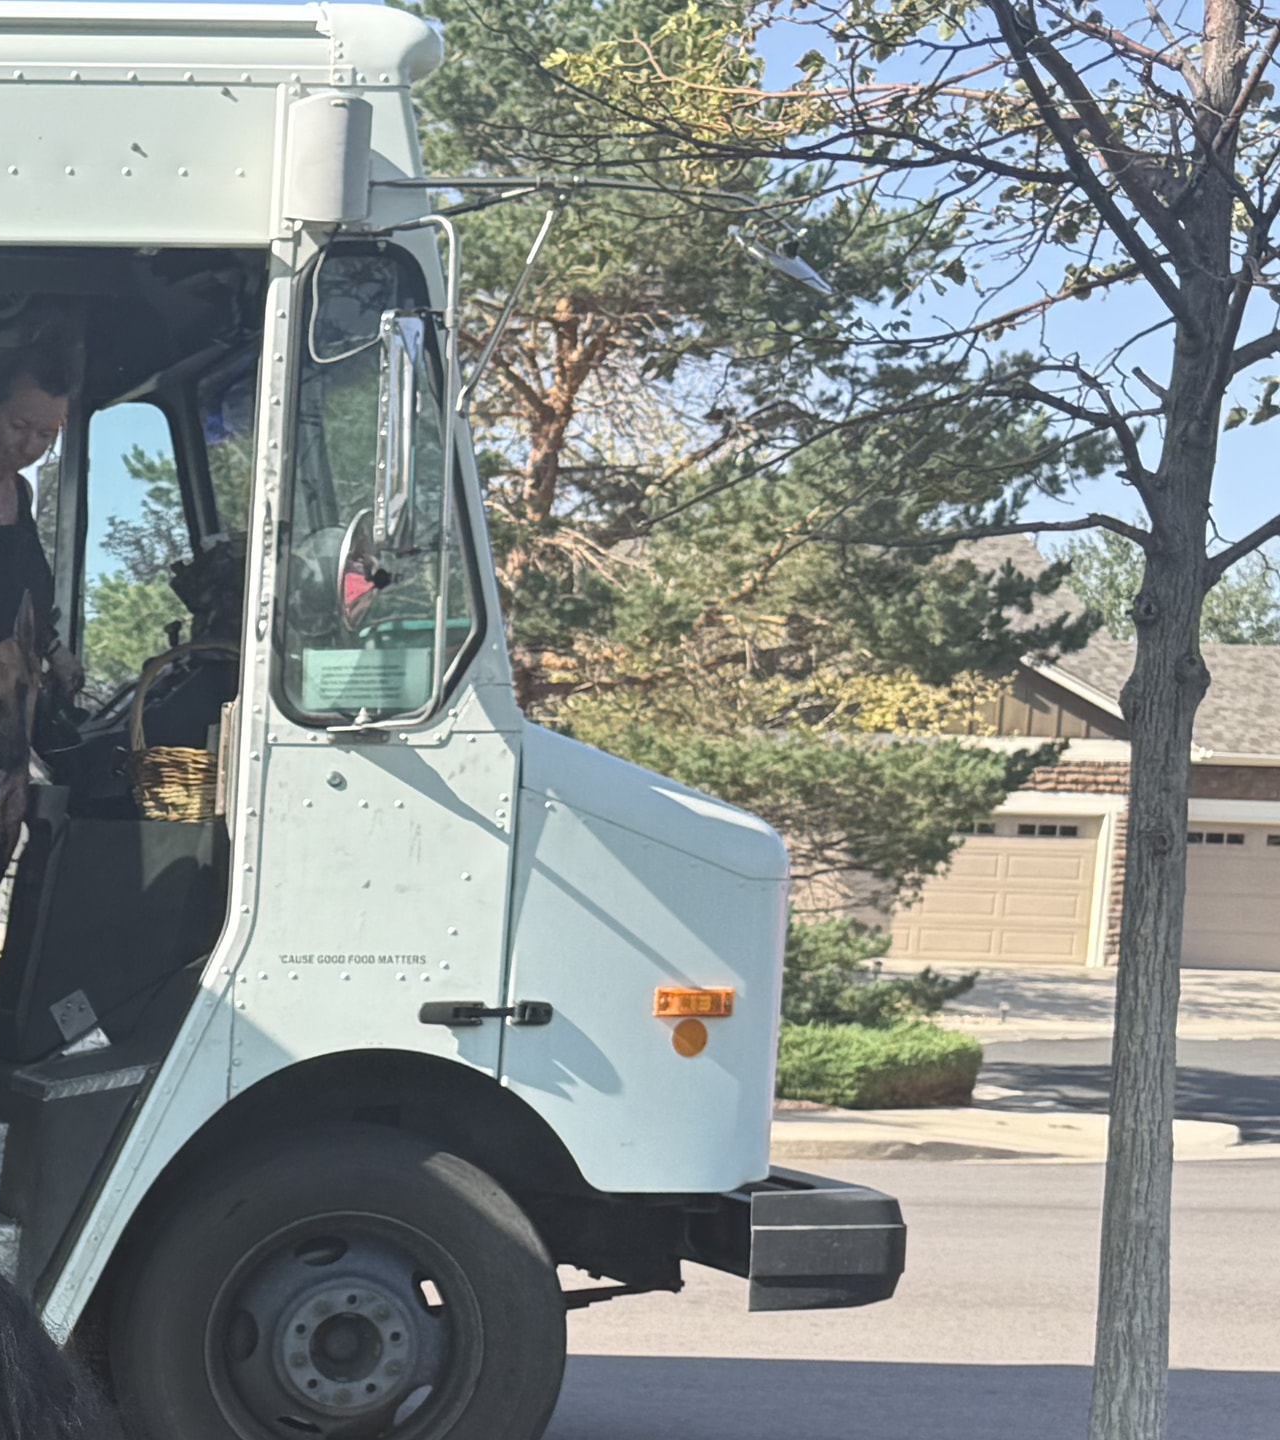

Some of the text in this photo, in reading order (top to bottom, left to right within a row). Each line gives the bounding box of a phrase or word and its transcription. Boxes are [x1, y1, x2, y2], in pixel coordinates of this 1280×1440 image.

[316, 953, 346, 965] GOOD
[347, 953, 376, 965] FOOD
[377, 953, 427, 965] MATTERS
